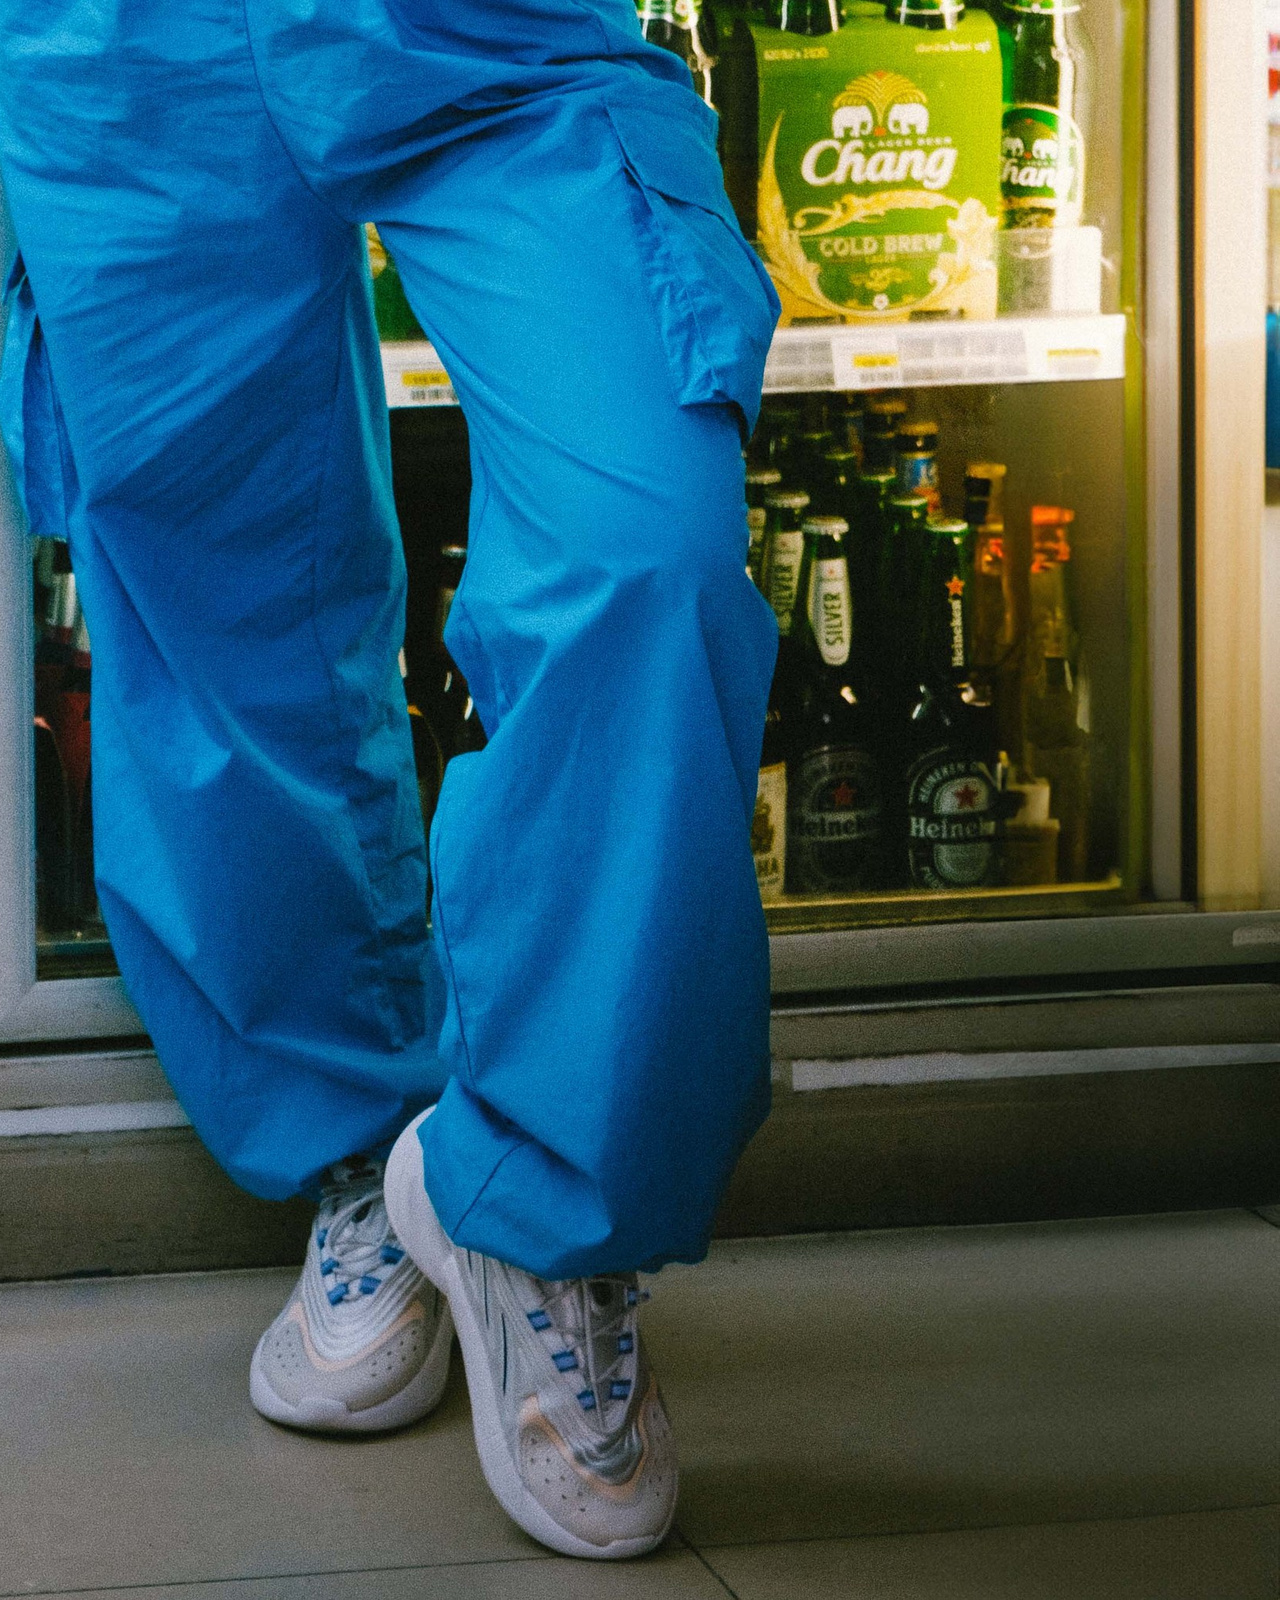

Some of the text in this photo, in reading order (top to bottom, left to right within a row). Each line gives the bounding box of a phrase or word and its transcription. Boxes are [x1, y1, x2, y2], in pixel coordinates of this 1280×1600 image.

[801, 137, 957, 190] Chang
[820, 233, 944, 257] COLD BREW
[824, 592, 844, 649] SILVER
